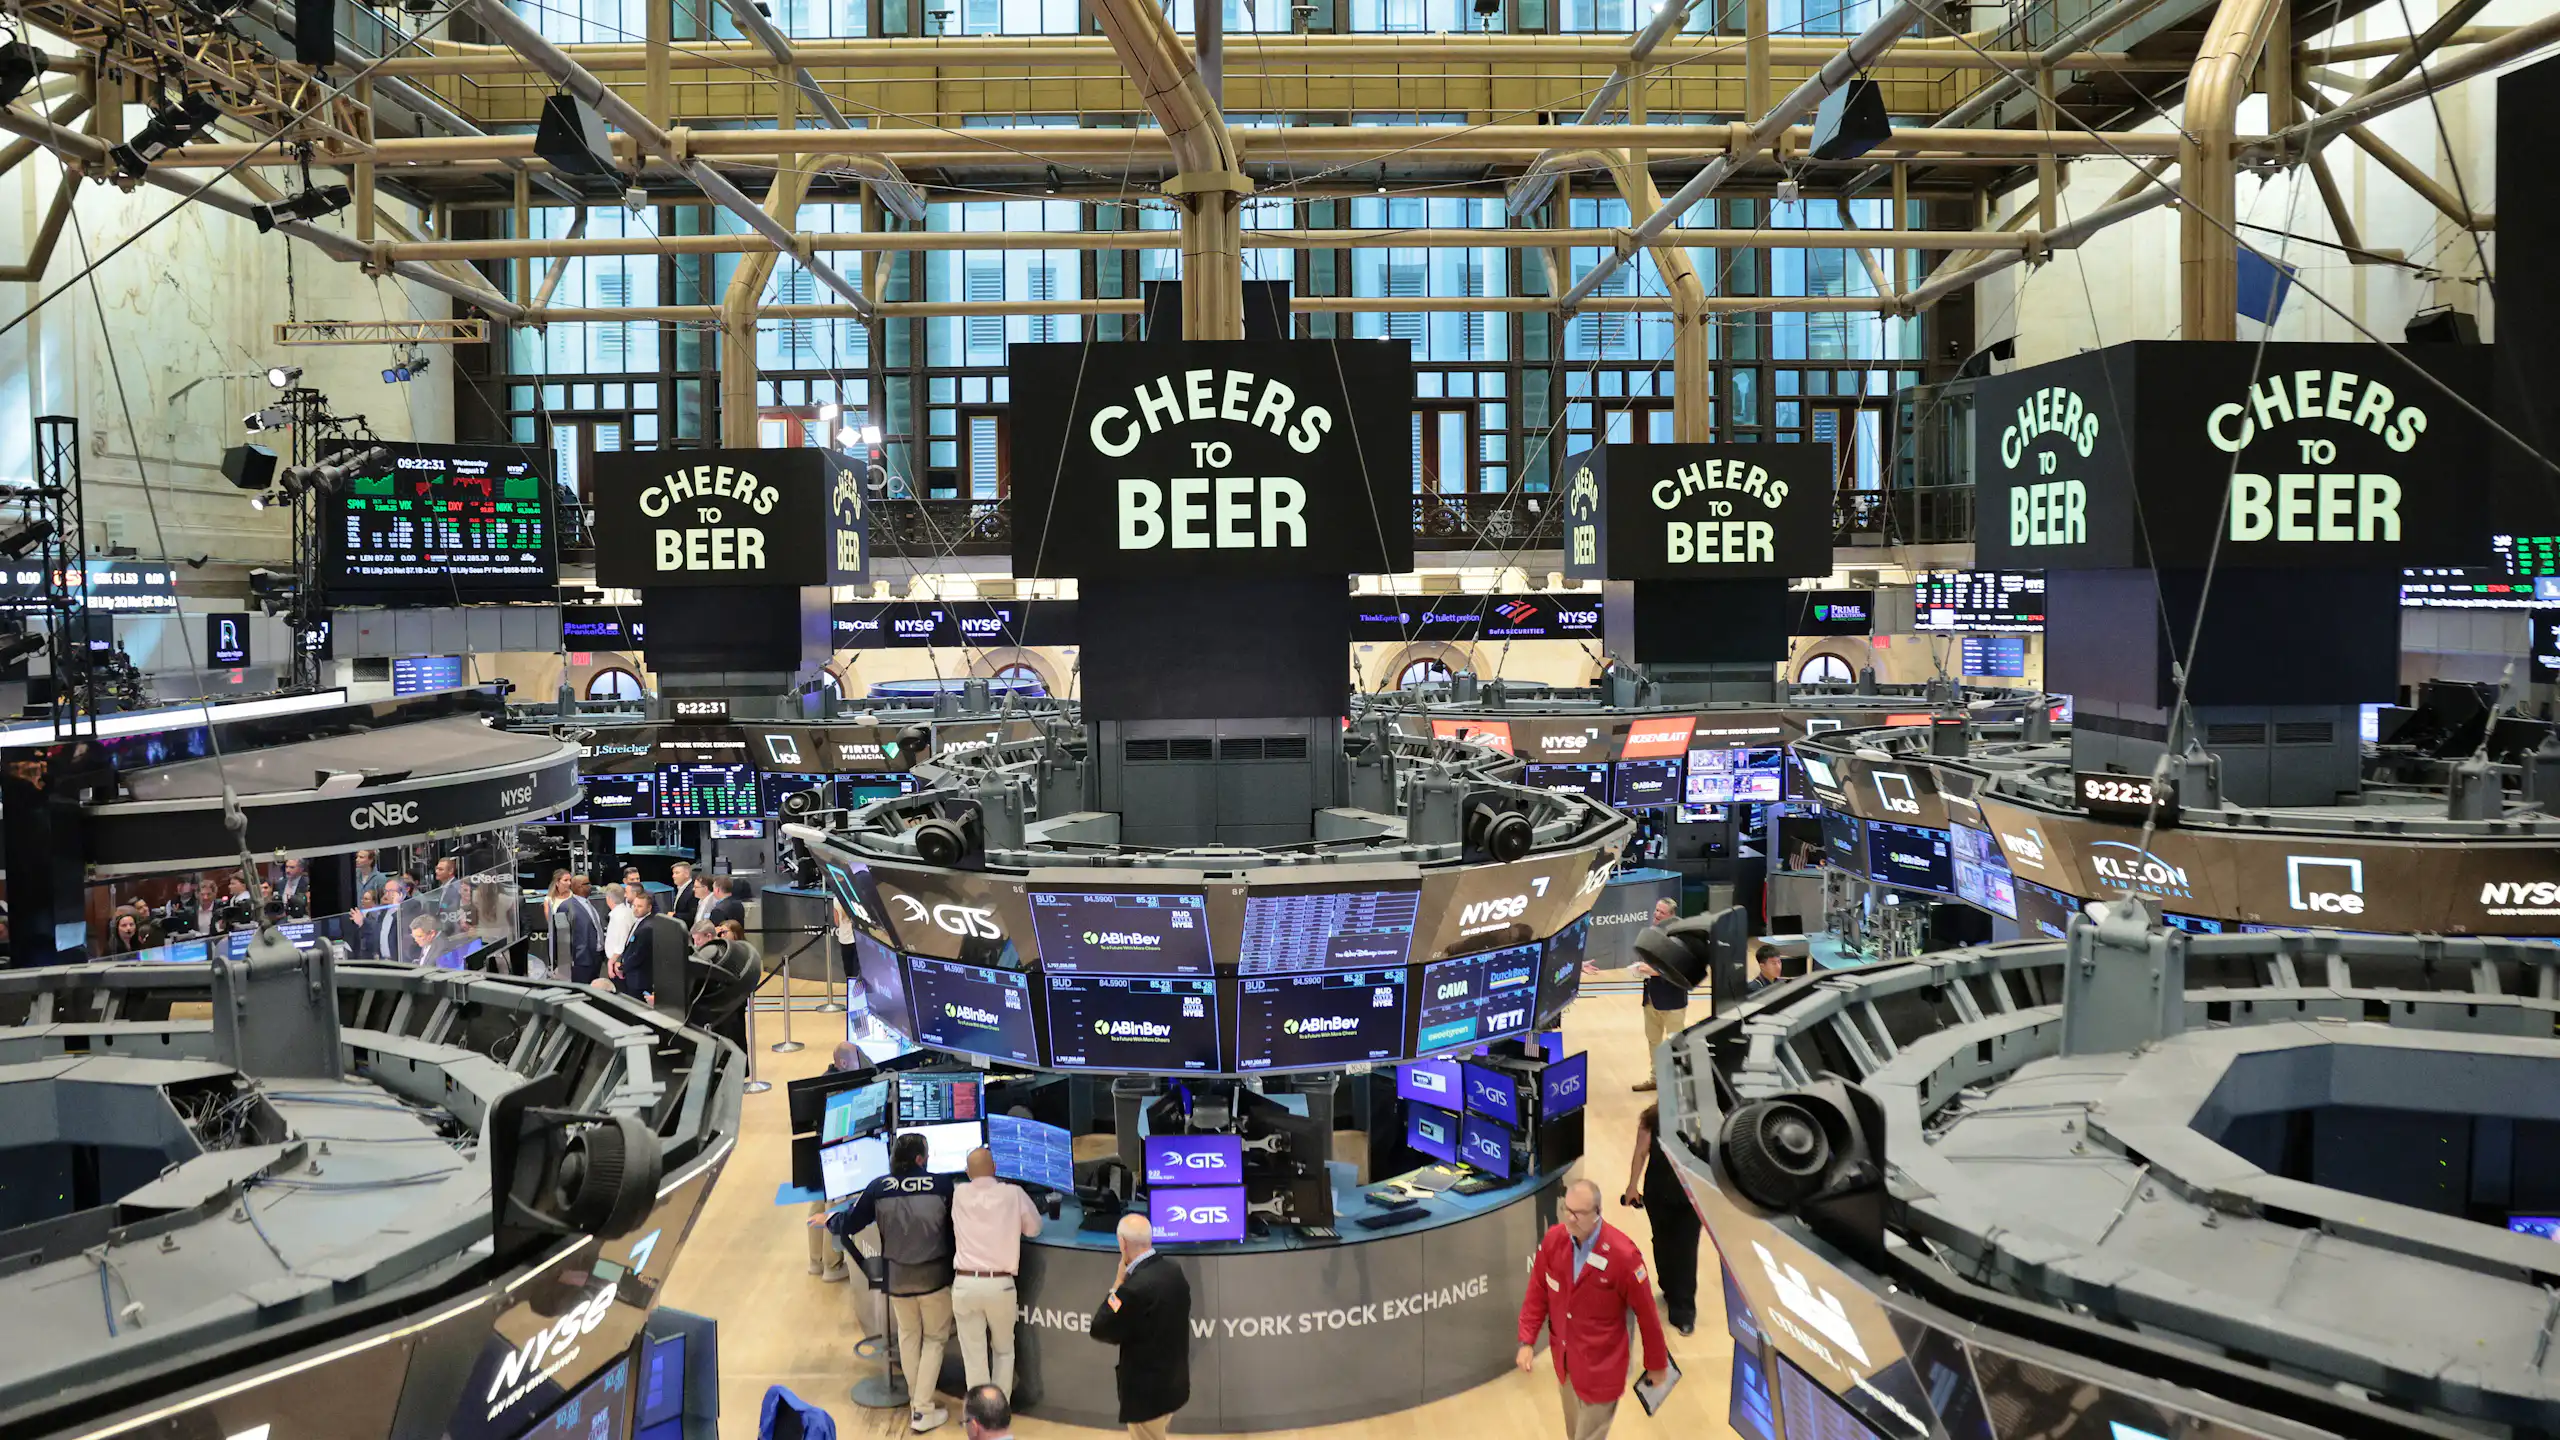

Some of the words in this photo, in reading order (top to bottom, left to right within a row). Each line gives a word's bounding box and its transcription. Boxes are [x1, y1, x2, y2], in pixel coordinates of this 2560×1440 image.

[1090, 368, 1332, 457] CHEERS
[2207, 369, 2427, 453] CHEERS
[2001, 386, 2099, 469] CHEERS
[1191, 441, 1233, 468] TO
[2298, 439, 2336, 466] TO
[397, 458, 446, 470] 09:22:31
[452, 459, 488, 468] Wednesday
[2038, 450, 2057, 475] TO
[639, 465, 780, 517] CHEERS
[1571, 467, 1598, 516] CHEERS
[1652, 459, 1789, 511] CHEERS
[833, 469, 861, 520] CHEERS
[399, 500, 412, 510] VIX
[448, 502, 463, 511] DXY
[1118, 476, 1307, 550] BEER
[1708, 500, 1733, 517] TO
[2009, 479, 2087, 547] BEER
[2230, 473, 2402, 542] BEER
[697, 507, 722, 524] TO
[845, 510, 851, 525] TO
[1581, 506, 1587, 521] TO
[656, 527, 766, 571] BEER
[837, 529, 860, 571] BEER
[1574, 525, 1596, 565] BEER
[1667, 521, 1774, 564] BEER
[17, 572, 41, 584] 0.00
[145, 573, 165, 584] 0.00
[371, 567, 383, 575] Lilly
[838, 620, 878, 631] BayCrest
[1360, 614, 1398, 622] ThinkEquity
[677, 702, 726, 714] 9:22:31
[1629, 731, 1689, 744] ROSENBLATT
[593, 743, 653, 757] J.Streicher
[839, 745, 880, 754] VIRTU
[2085, 779, 2165, 806] 9:22:3
[350, 800, 419, 830] CNBC
[2100, 877, 2193, 899] FINNCIAL
[1036, 895, 1056, 903] BUD
[933, 904, 1001, 940] GTS
[1597, 911, 1649, 926] EXCHANGE
[1100, 932, 1160, 945] ABInBev
[911, 960, 926, 969] BUD
[944, 964, 964, 974] 84.5900
[1052, 979, 1072, 987] BUD
[1099, 979, 1127, 987] 84.5900
[1293, 977, 1321, 986] 84.5900
[1343, 974, 1363, 983] 85.23
[1384, 971, 1404, 980] 85.28
[1150, 980, 1170, 988] 85.23
[1192, 981, 1212, 989] 85.28
[1245, 981, 1266, 990] BUD
[1437, 980, 1468, 1000] CAVA
[1373, 1000, 1393, 1008] NYSE
[956, 1005, 998, 1024] ABInBev
[1486, 1008, 1526, 1033] YETI
[1110, 1021, 1171, 1036] ABInBev
[1299, 1016, 1359, 1032] ABInBev
[1427, 1025, 1469, 1041] sweetgreen
[1560, 1075, 1580, 1096] GTS
[1485, 1086, 1508, 1107] GTS
[1481, 1139, 1501, 1160] GTS
[901, 1176, 934, 1192] GTS
[1223, 1315, 1293, 1338] YORK
[1299, 1304, 1377, 1333] STOCK
[1383, 1275, 1488, 1321] EXCHANGE
[1016, 1304, 1091, 1333] HANGE
